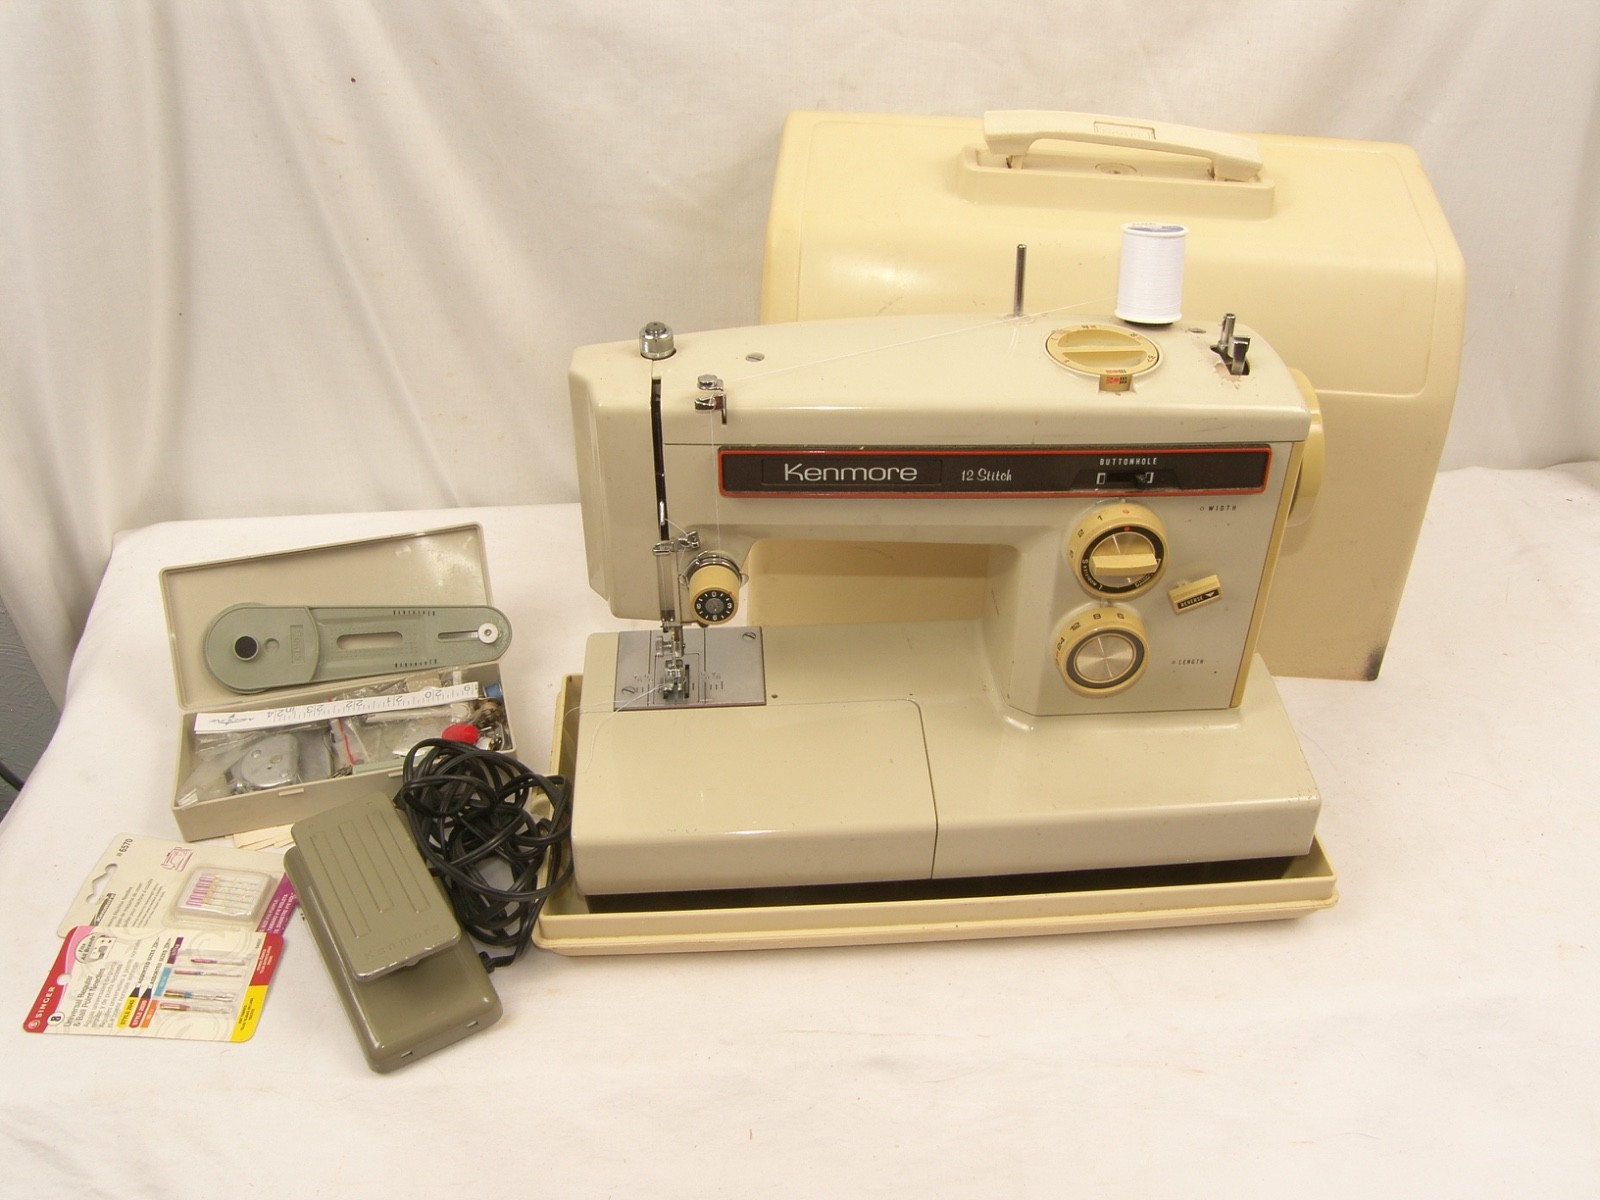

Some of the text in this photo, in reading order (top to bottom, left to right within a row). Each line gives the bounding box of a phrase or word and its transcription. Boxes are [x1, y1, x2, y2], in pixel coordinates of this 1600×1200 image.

[1100, 457, 1158, 466] BUTTONHOLE
[784, 463, 1012, 482] Kenmore 12 Stitch
[1180, 596, 1203, 608] REVERSE
[1178, 658, 1204, 666] LENGTH
[76, 1010, 86, 1021] Ball
[82, 992, 94, 1008] Point
[89, 968, 106, 991] Needles
[36, 986, 56, 1018] SINGER
[64, 976, 93, 1027] Universal Regular
[51, 1016, 62, 1024] 8
[120, 1012, 130, 1025] STYLE
[132, 1012, 142, 1026] STYLE
